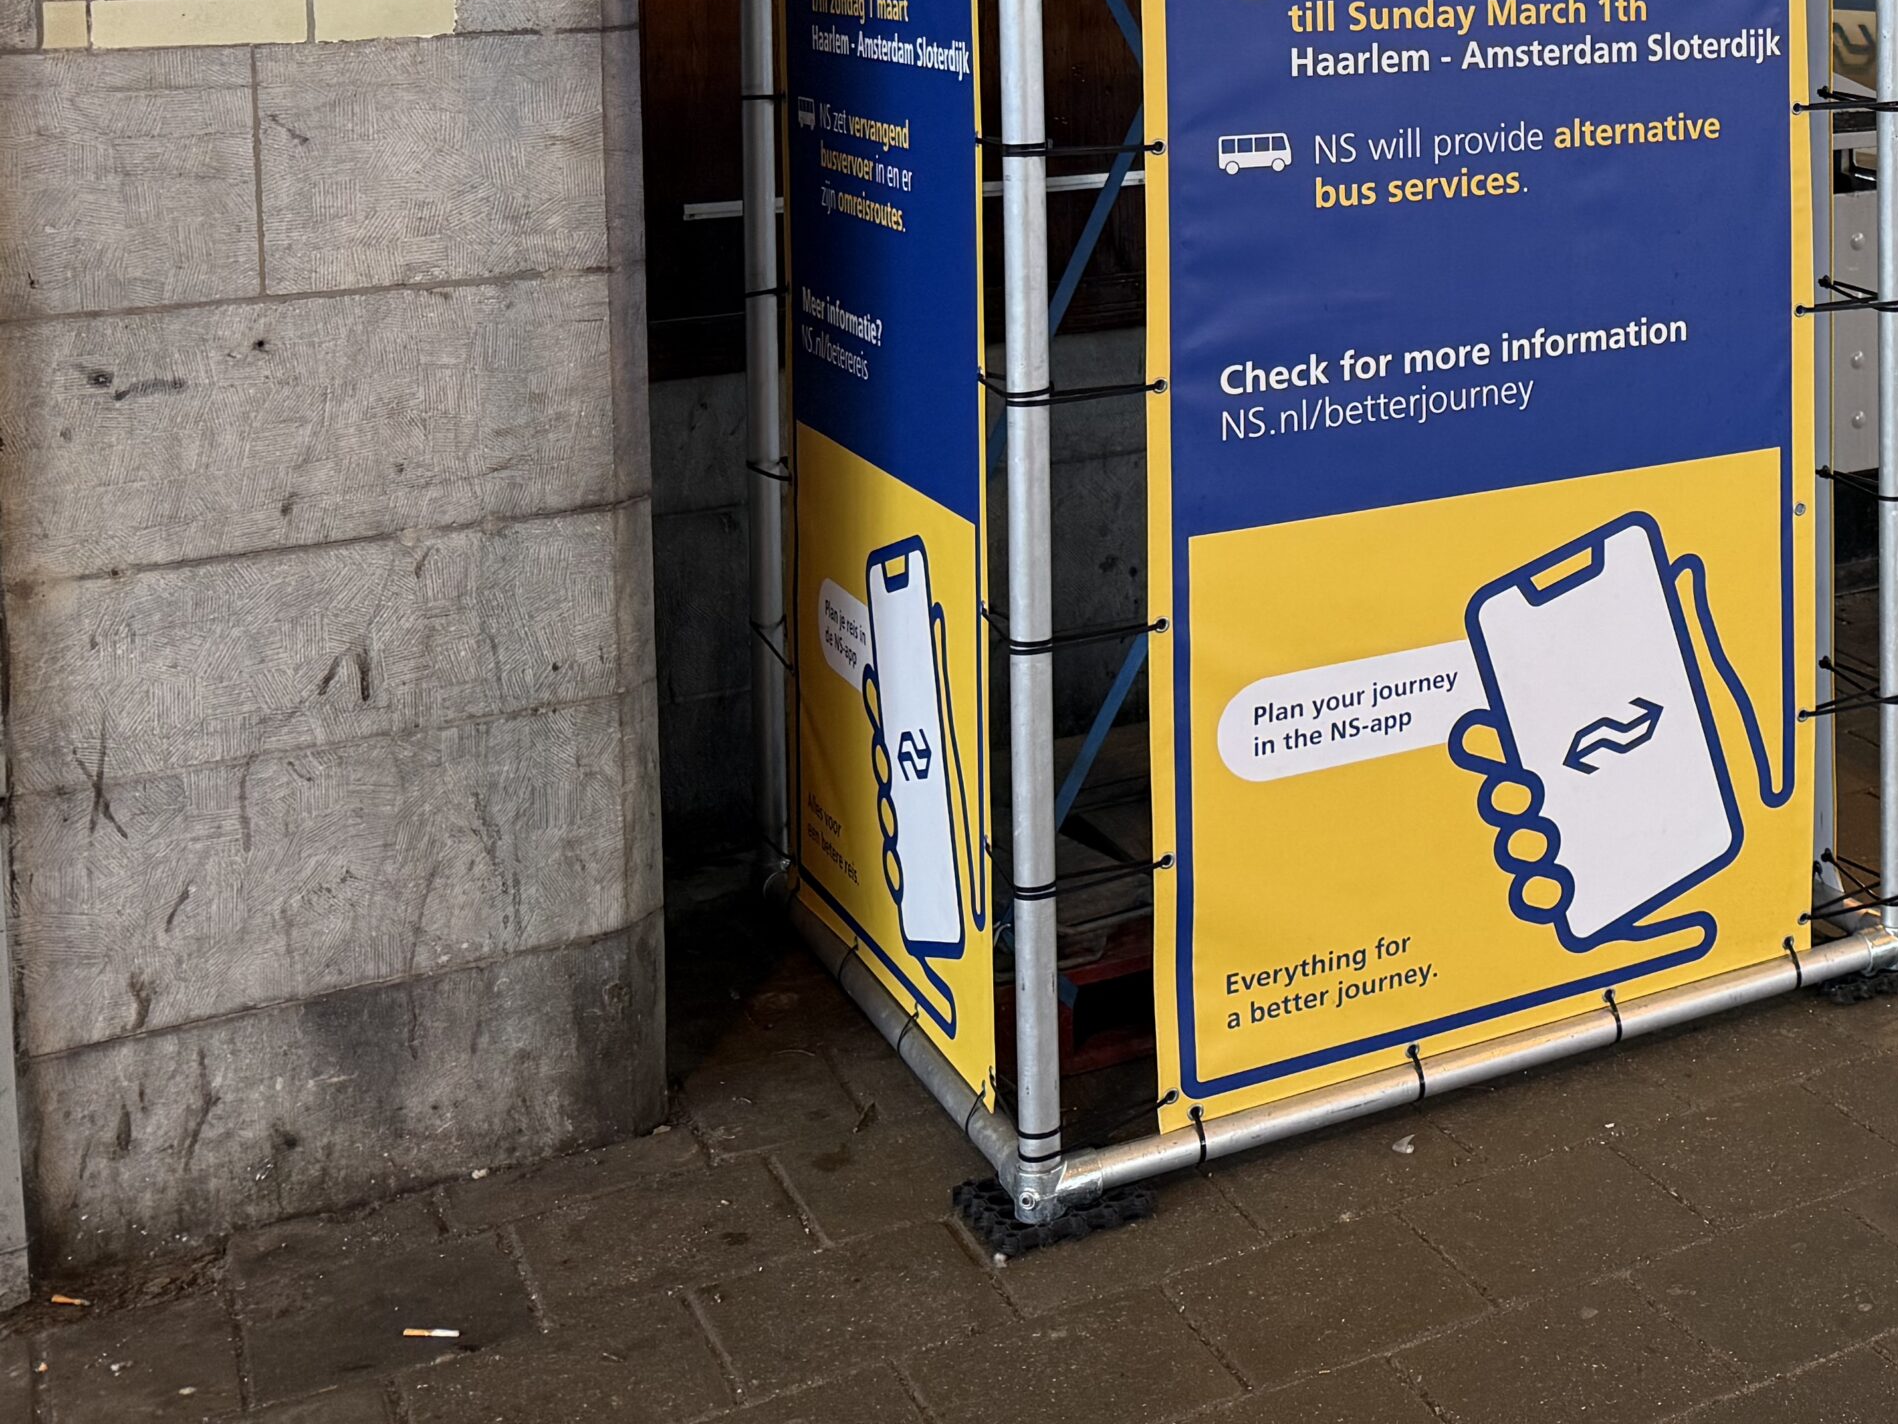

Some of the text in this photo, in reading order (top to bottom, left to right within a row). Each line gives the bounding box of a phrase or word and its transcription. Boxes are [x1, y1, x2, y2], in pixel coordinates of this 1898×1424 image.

[1287, 0, 1335, 33] till
[812, 25, 850, 55] Haarlem
[857, 30, 914, 66] Amsterdam
[916, 36, 970, 81] Sloterdijk
[1291, 42, 1430, 77] Haarlem
[1461, 34, 1637, 70] Amsterdam
[1647, 27, 1781, 64] Sloterdijk
[833, 109, 847, 134] zet
[848, 115, 910, 152] vervangend
[1315, 111, 1721, 165] NS will provide alternative
[820, 139, 913, 192] busvervoer in en er
[1315, 167, 1528, 209] bus services.
[837, 191, 906, 232] omreisroutes.
[802, 286, 882, 347] Meer informatie?
[1220, 316, 1687, 395] Check for more information
[1222, 380, 1534, 441] NS.nl/betterjourney
[1253, 671, 1458, 726] Plan your journey
[1254, 711, 1412, 757] in the NS-app
[1226, 936, 1411, 1000] Everything for
[1227, 963, 1438, 1030] a better journey.
